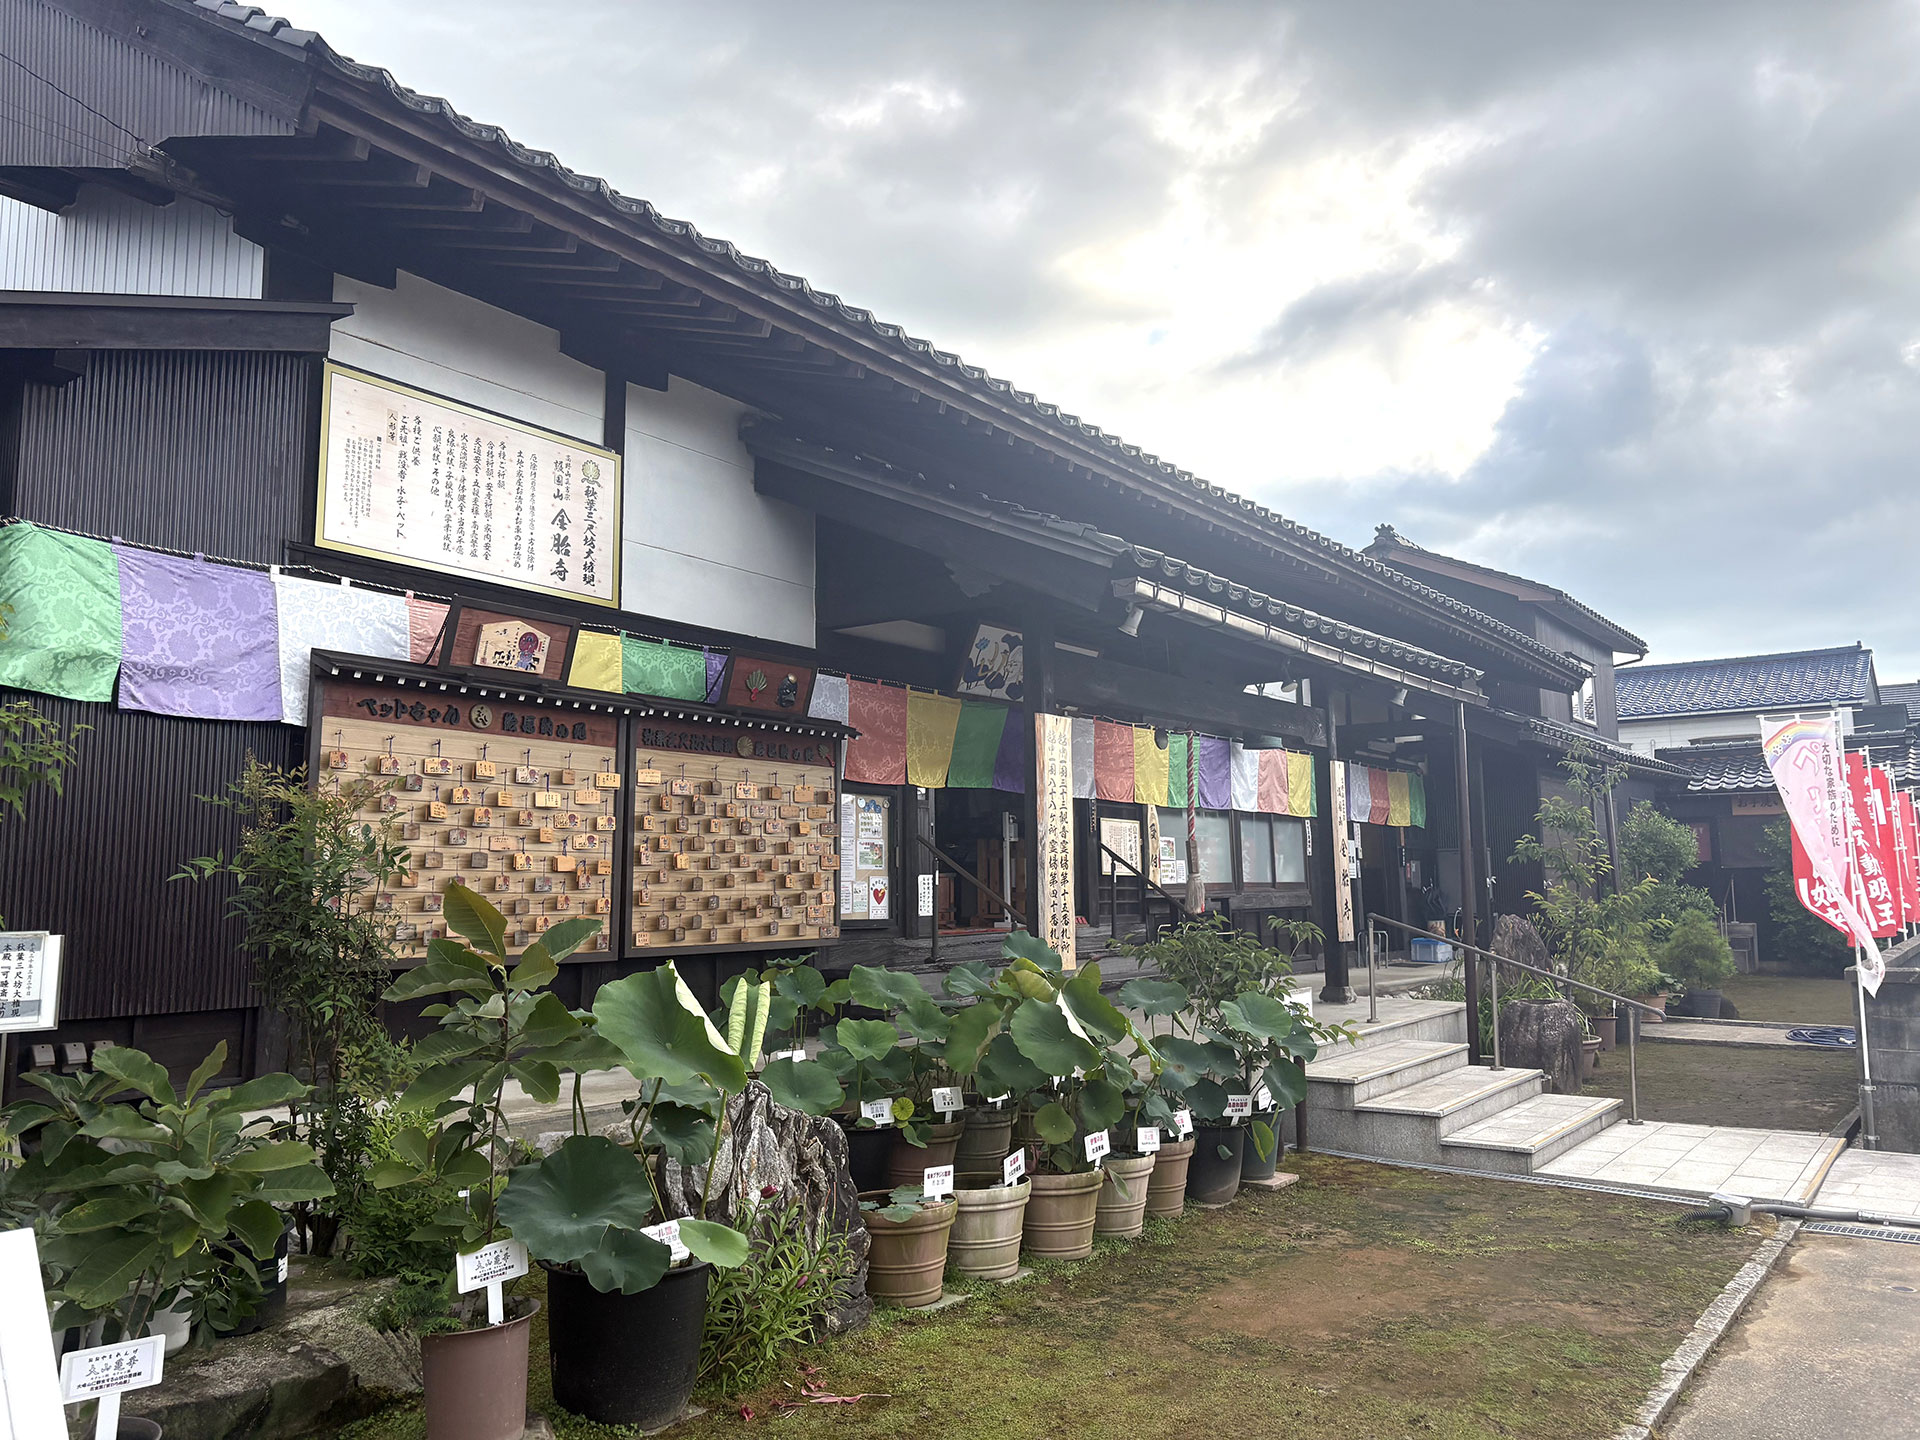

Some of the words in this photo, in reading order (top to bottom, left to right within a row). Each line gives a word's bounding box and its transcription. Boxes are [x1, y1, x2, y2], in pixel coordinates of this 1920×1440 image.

[550, 508, 572, 582] 金胎寺
[582, 485, 598, 587] 秋葉三尺坊大権現
[1821, 742, 1841, 848] 大切な家族のために
[10, 942, 26, 1017] 秋葉三尺坊大権現
